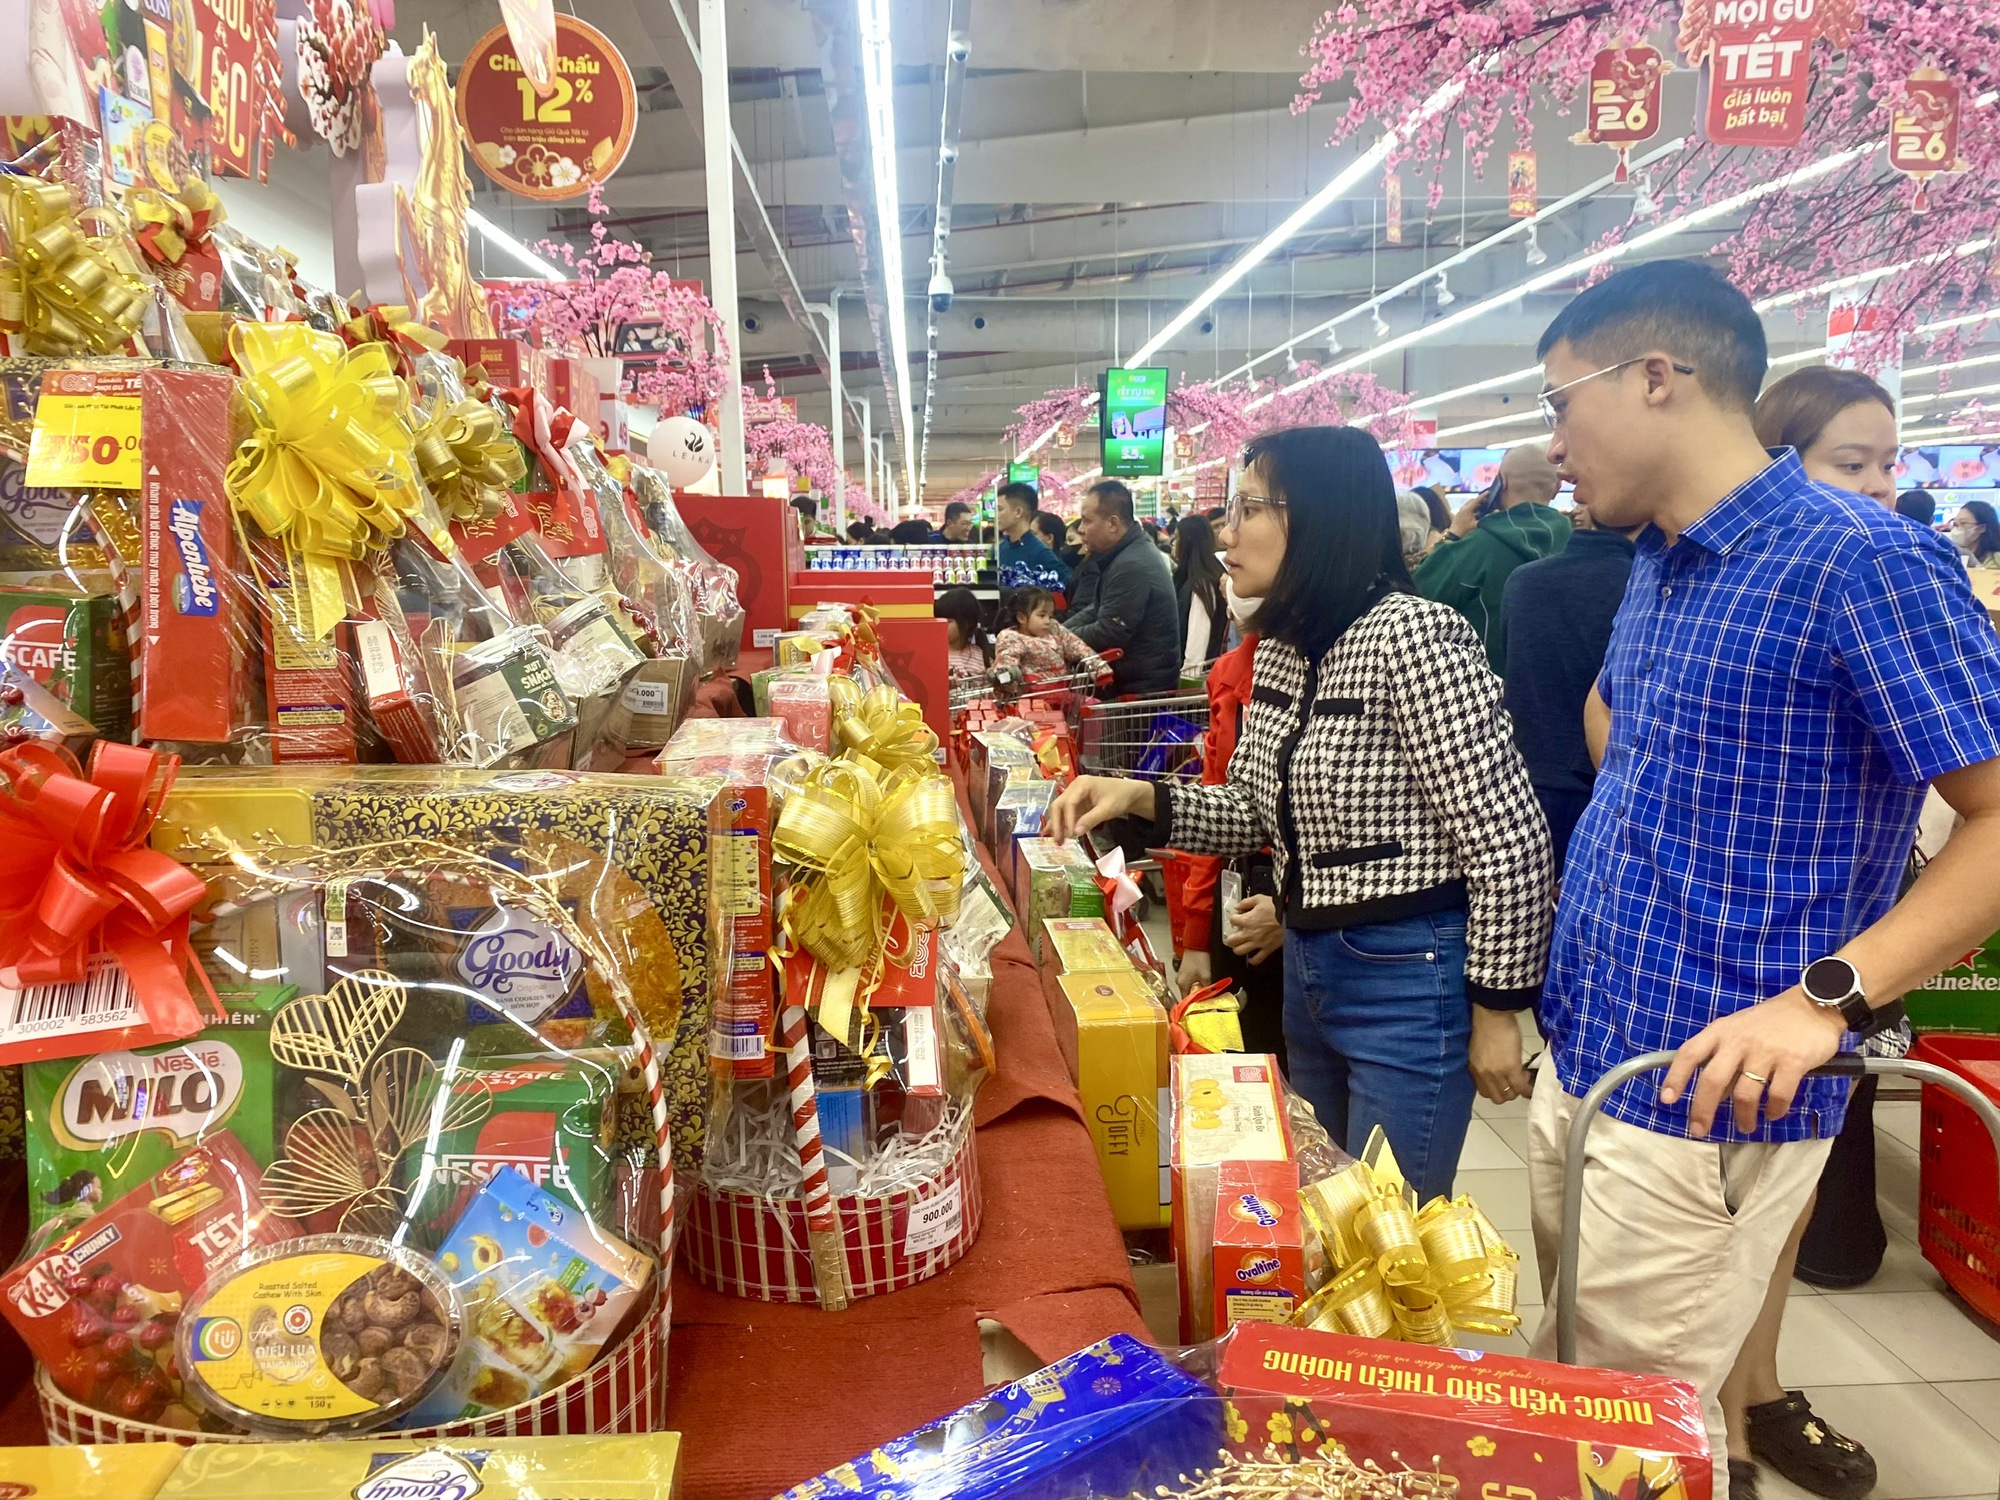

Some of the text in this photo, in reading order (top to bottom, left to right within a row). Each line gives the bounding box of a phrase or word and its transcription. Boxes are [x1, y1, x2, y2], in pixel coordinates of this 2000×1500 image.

[1719, 27, 1803, 81] TẾT
[517, 76, 594, 123] 12%
[1723, 86, 1792, 110] Giá luôn
[1725, 106, 1786, 130] bất bại
[672, 450, 711, 464] LEIKA
[168, 507, 217, 607] Alpenliebe
[465, 929, 572, 990] Goody
[1914, 973, 2000, 991] eineke
[17, 1018, 65, 1035] 300002
[80, 1010, 127, 1026] 583562
[76, 1072, 225, 1125] MILO
[923, 1200, 953, 1223] 900.000
[73, 1227, 115, 1262] CHUNKY
[188, 1212, 243, 1257] TẾT
[259, 1281, 317, 1290] Roasted Salted
[1236, 1259, 1281, 1281] Ovaltine
[253, 1289, 322, 1299] Cashew With Skin
[1262, 1349, 1352, 1382] HOÀNG
[1446, 1376, 1502, 1409] SÀO
[1509, 1384, 1568, 1418] YẾN
[1573, 1393, 1655, 1427] NƯỚC
